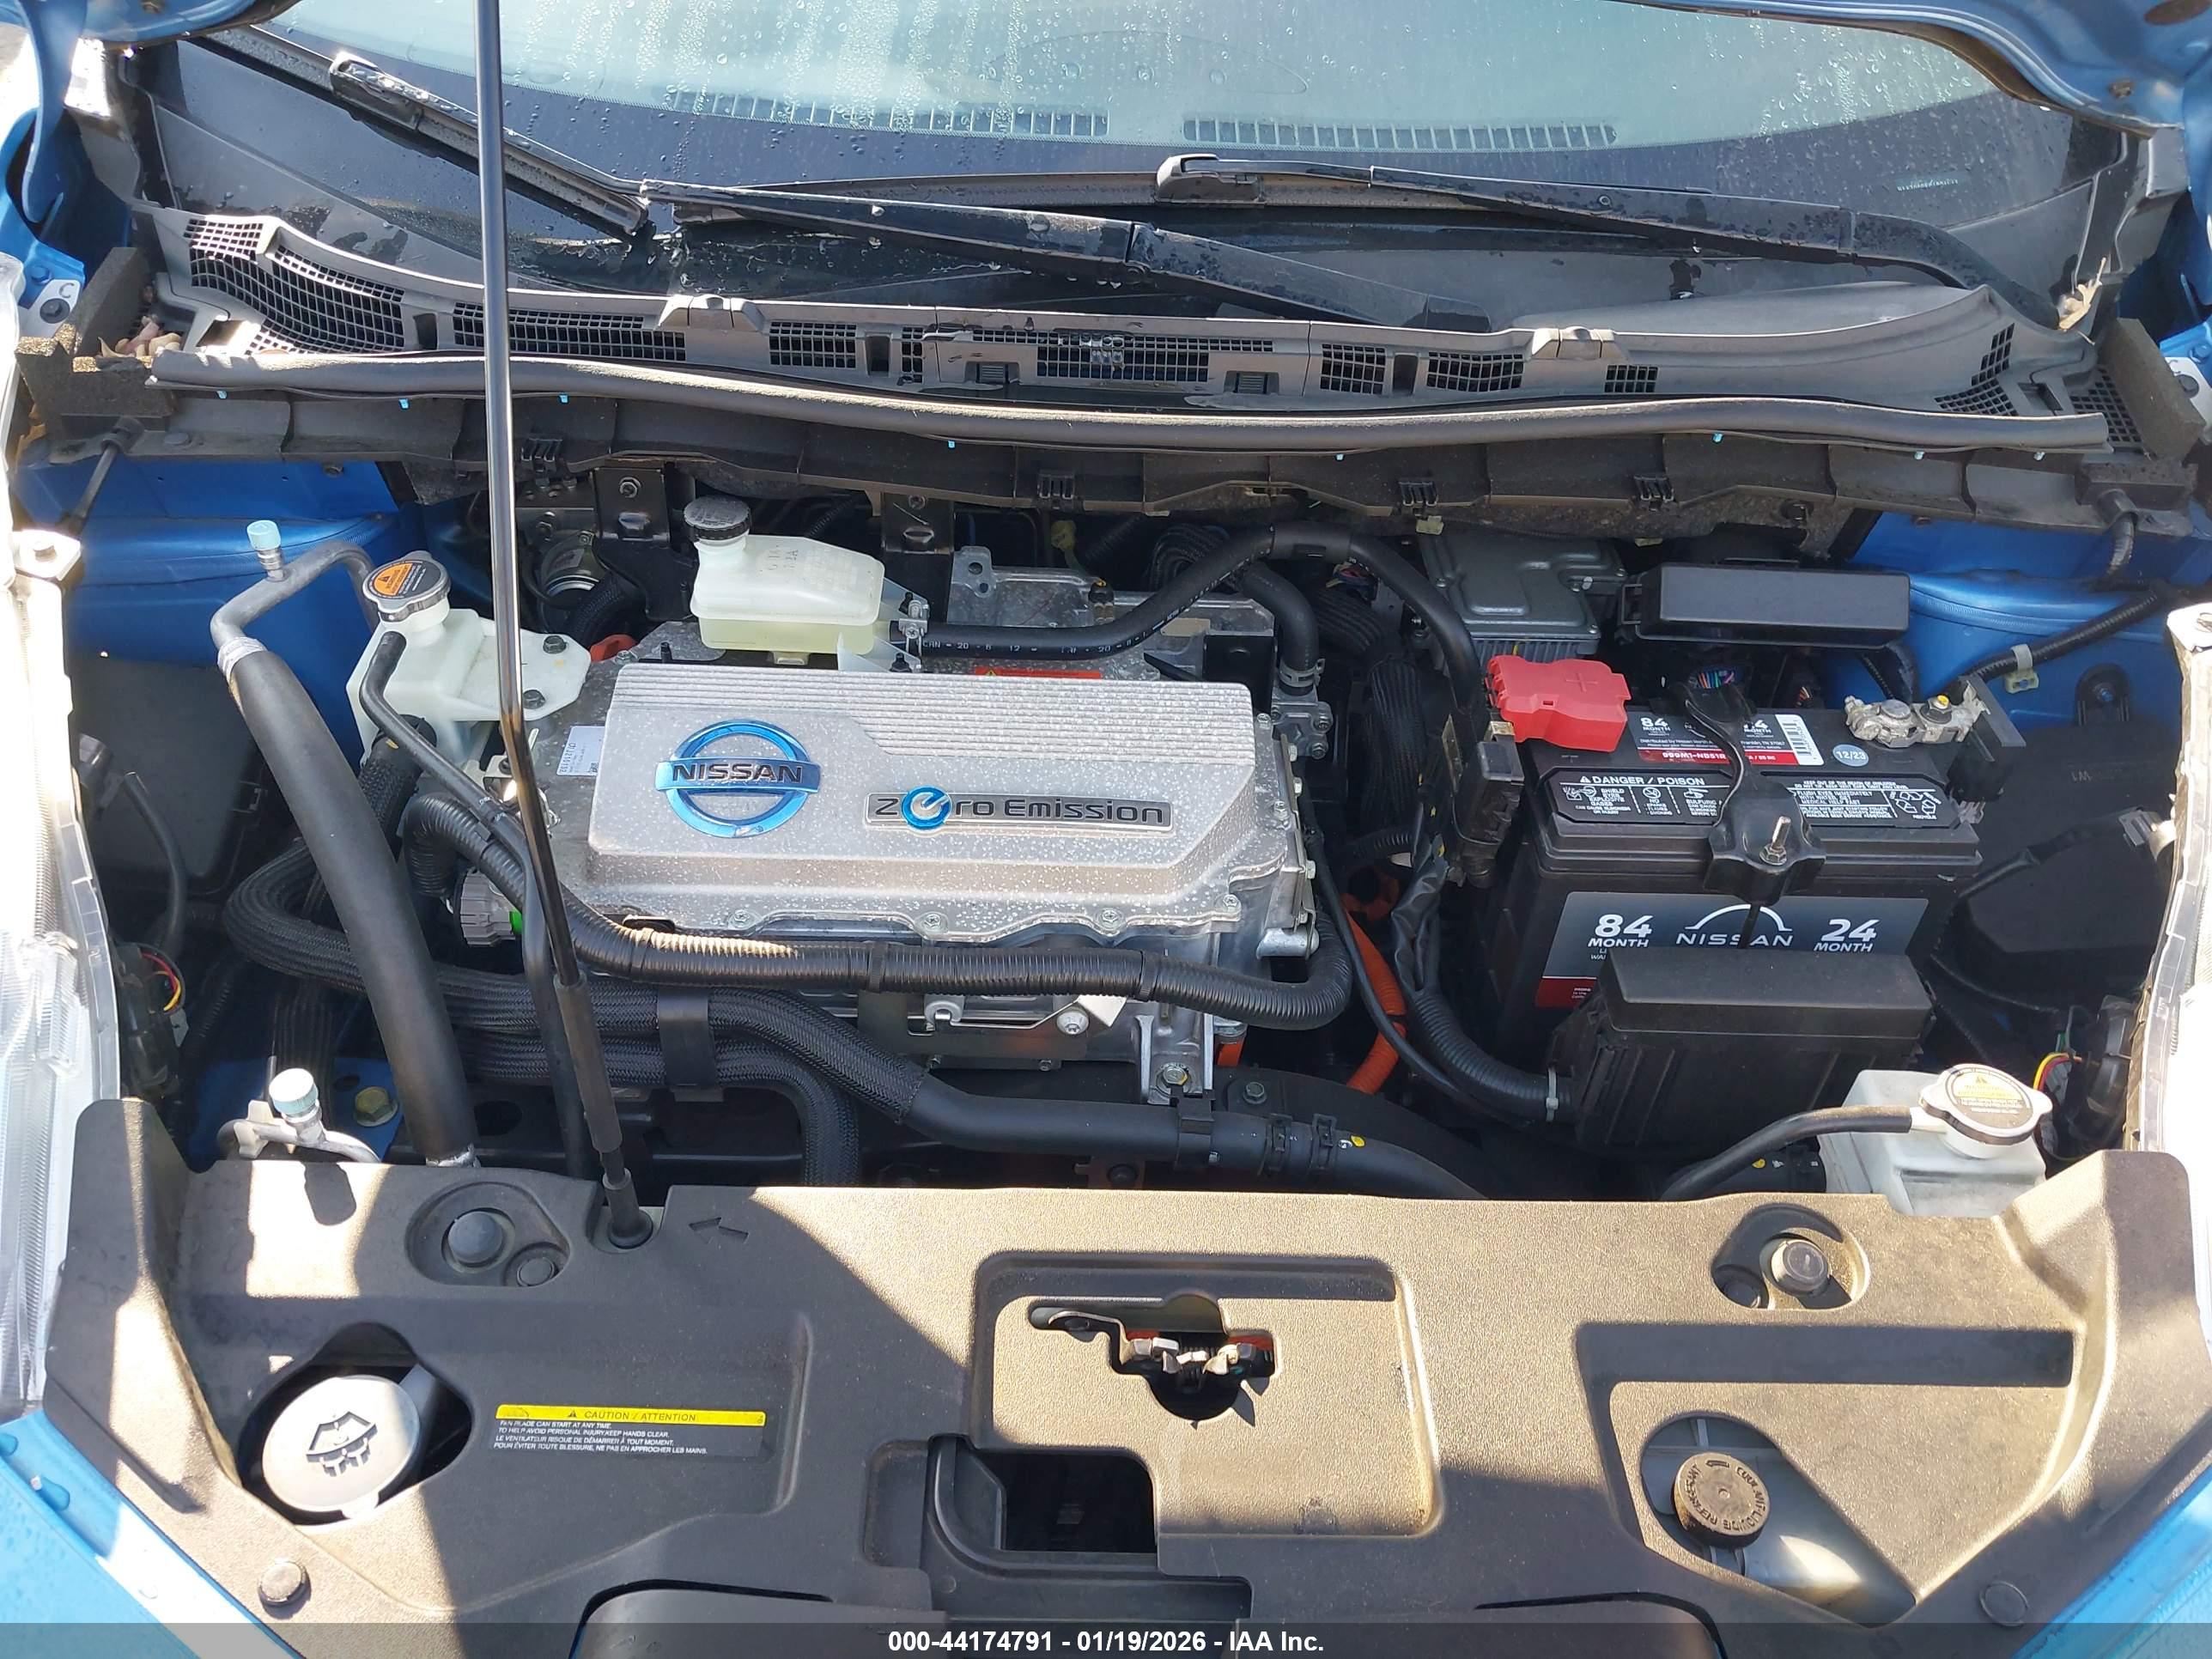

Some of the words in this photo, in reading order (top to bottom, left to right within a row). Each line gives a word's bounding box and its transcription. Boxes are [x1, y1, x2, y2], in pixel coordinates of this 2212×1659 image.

[1640, 717, 1668, 727] 84
[1835, 750, 1866, 760] 12/23
[672, 763, 803, 784] NISSAN
[1592, 775, 1644, 784] DANGER
[1657, 776, 1705, 786] POISON
[1005, 798, 1164, 823] Emission
[1595, 914, 1654, 938] 84
[1820, 918, 1880, 942] 24
[1587, 938, 1649, 947] MONTH
[1814, 942, 1873, 952] MONTH
[584, 1411, 629, 1419] CAUTION
[641, 1413, 696, 1421] ATTENTION
[505, 1435, 547, 1443] VENTILATEUR
